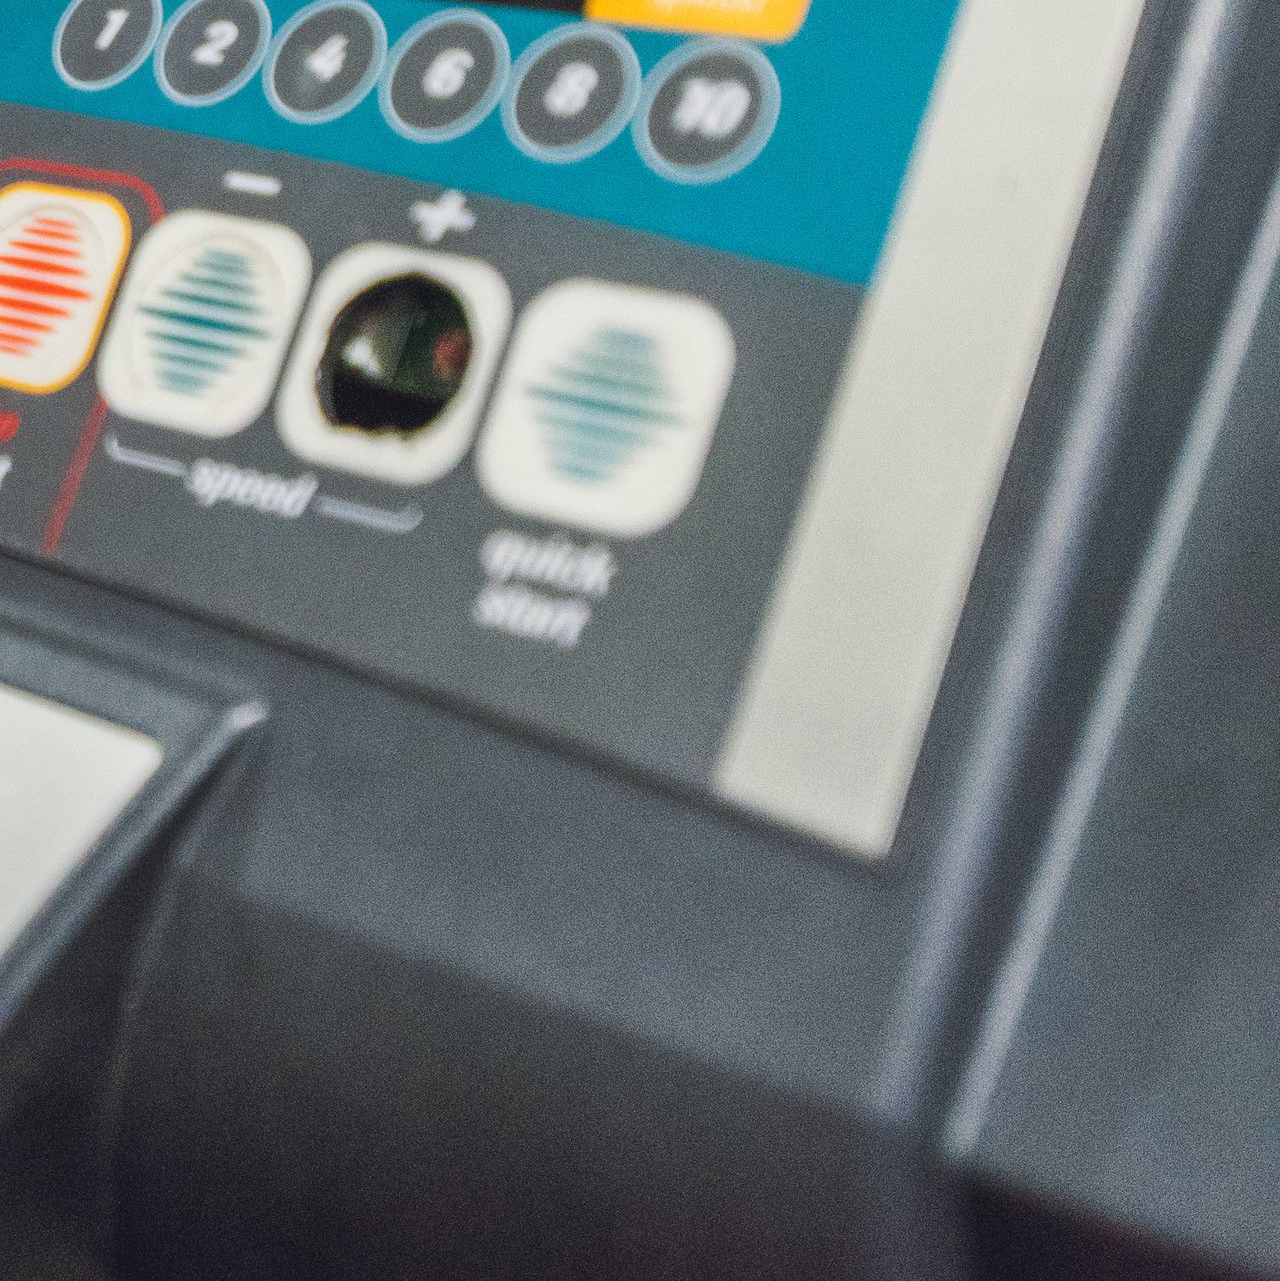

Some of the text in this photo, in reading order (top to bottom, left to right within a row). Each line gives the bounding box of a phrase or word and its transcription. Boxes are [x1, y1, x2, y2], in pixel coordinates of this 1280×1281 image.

[94, 10, 130, 50] 1
[194, 21, 238, 66] 2
[306, 36, 348, 82] 4
[424, 51, 473, 99] 6
[544, 62, 600, 118] 8
[672, 77, 752, 139] 10
[189, 458, 318, 518] speed
